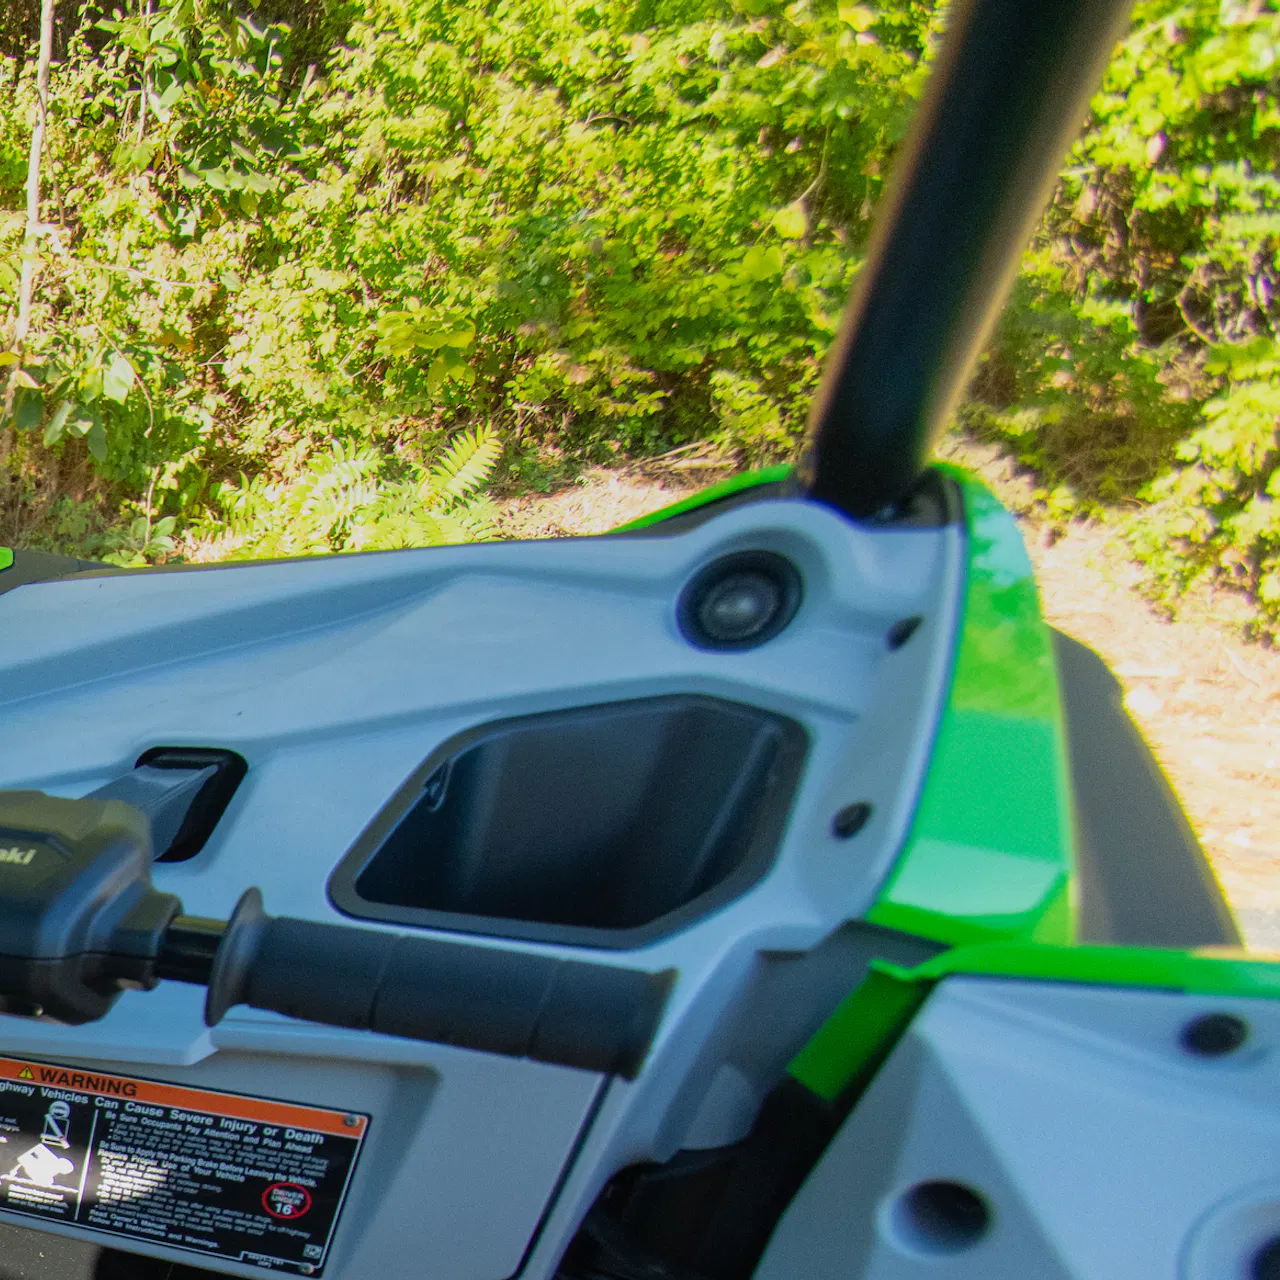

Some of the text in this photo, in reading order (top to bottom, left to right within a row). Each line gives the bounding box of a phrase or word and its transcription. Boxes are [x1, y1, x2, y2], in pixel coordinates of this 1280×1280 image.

[39, 1068, 138, 1096] WARNING
[39, 1087, 89, 1105] Vehicles
[94, 1096, 119, 1110] Can
[124, 1101, 164, 1118] Cause
[169, 1109, 214, 1126] Severe
[219, 1117, 257, 1134] Injury
[262, 1125, 278, 1137] or
[283, 1128, 325, 1145] Death
[104, 1110, 313, 1153] Be Sure Occupants Pay Attention and Plan Ahead
[96, 1148, 246, 1183] Require Proper Use of Your Vehicle
[270, 1194, 301, 1205] UNDER
[273, 1202, 293, 1215] 16
